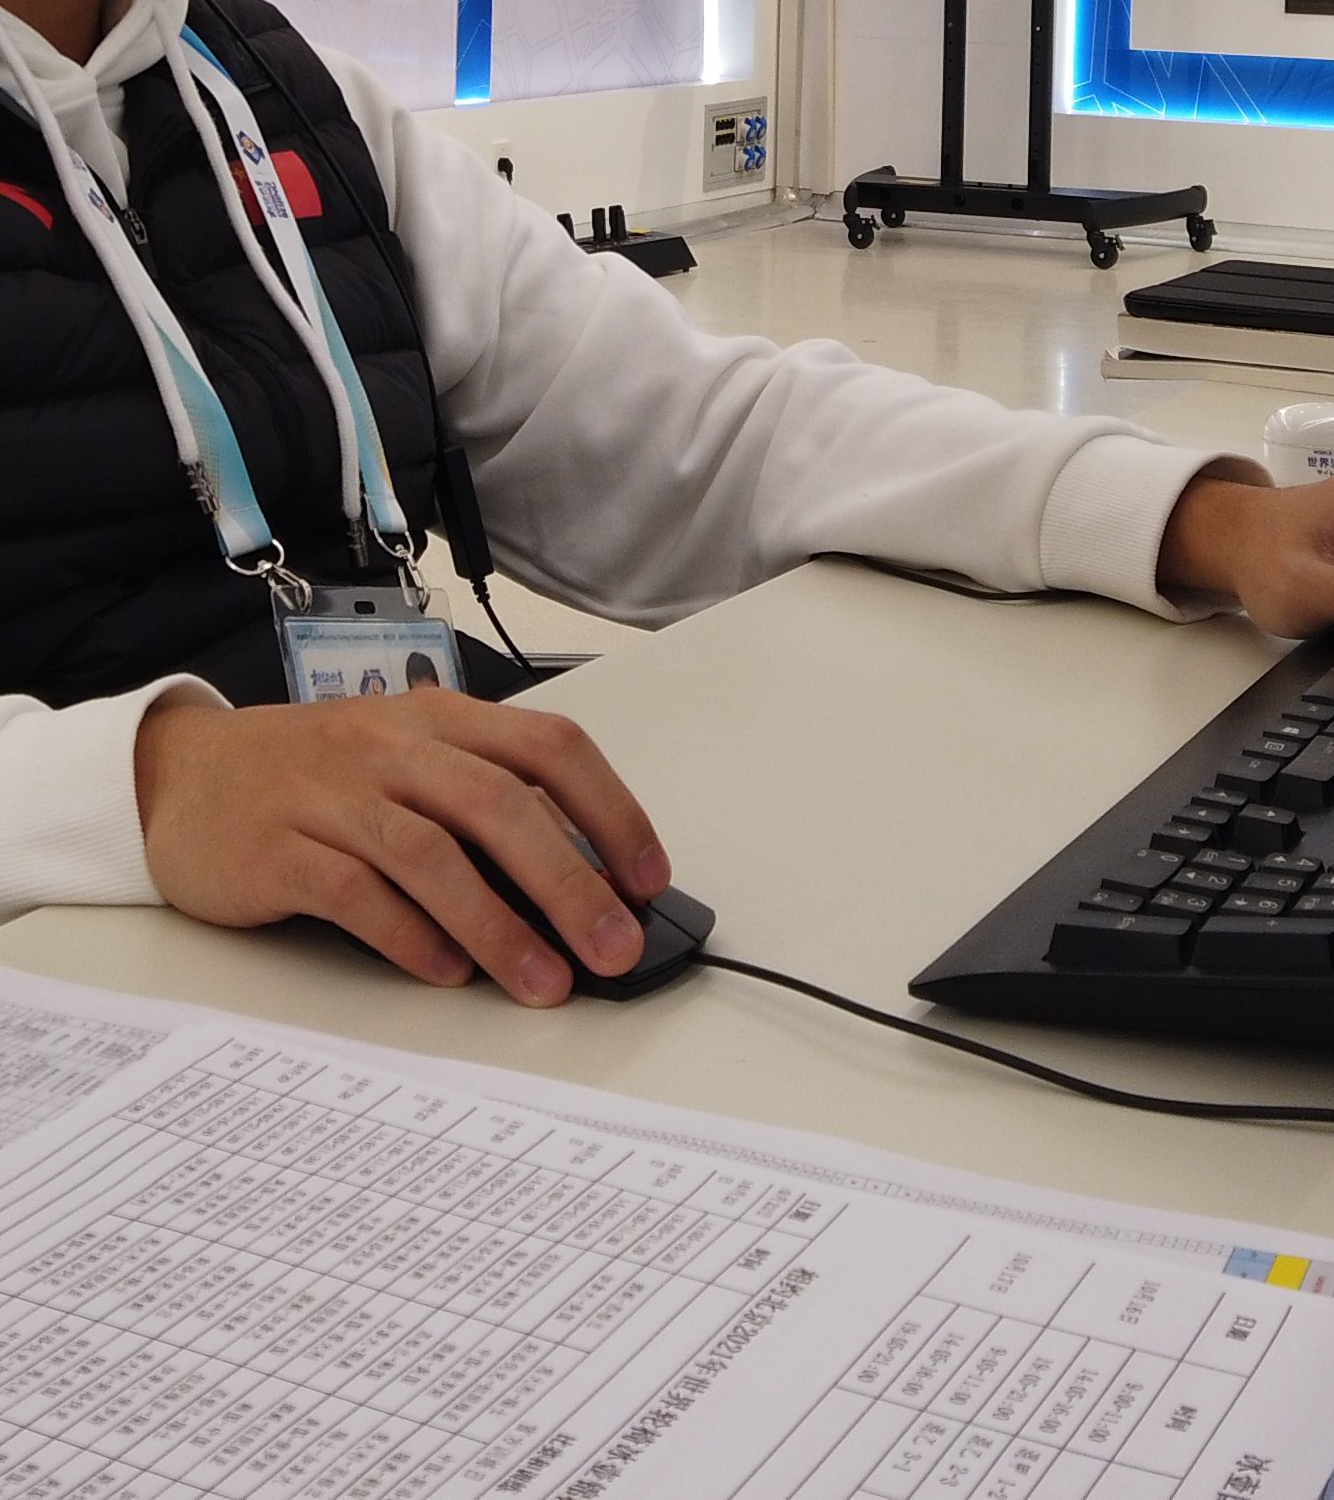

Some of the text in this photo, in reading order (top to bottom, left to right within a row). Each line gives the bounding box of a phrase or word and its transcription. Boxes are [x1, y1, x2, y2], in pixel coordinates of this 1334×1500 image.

[1228, 856, 1247, 865] 1
[1297, 856, 1314, 867] 4
[1207, 870, 1227, 886] 2
[1277, 877, 1297, 888] 5
[1186, 896, 1207, 909] 3
[1258, 899, 1280, 911] 6
[787, 1198, 823, 1223] 日期
[734, 1246, 777, 1273] 时间
[1223, 1313, 1259, 1343] 日期
[854, 1319, 924, 1386] 19:05-21:00
[900, 1329, 967, 1399] 14:05-16:00
[946, 1344, 1010, 1408] 9:05-11:00
[989, 1354, 1056, 1424] 19:05-21:00
[1038, 1365, 1101, 1436] 14:05-16:00
[1086, 1379, 1145, 1444] 9:00-11:00
[1163, 1402, 1200, 1433] 时间
[496, 1430, 579, 1492] 比赛和训练
